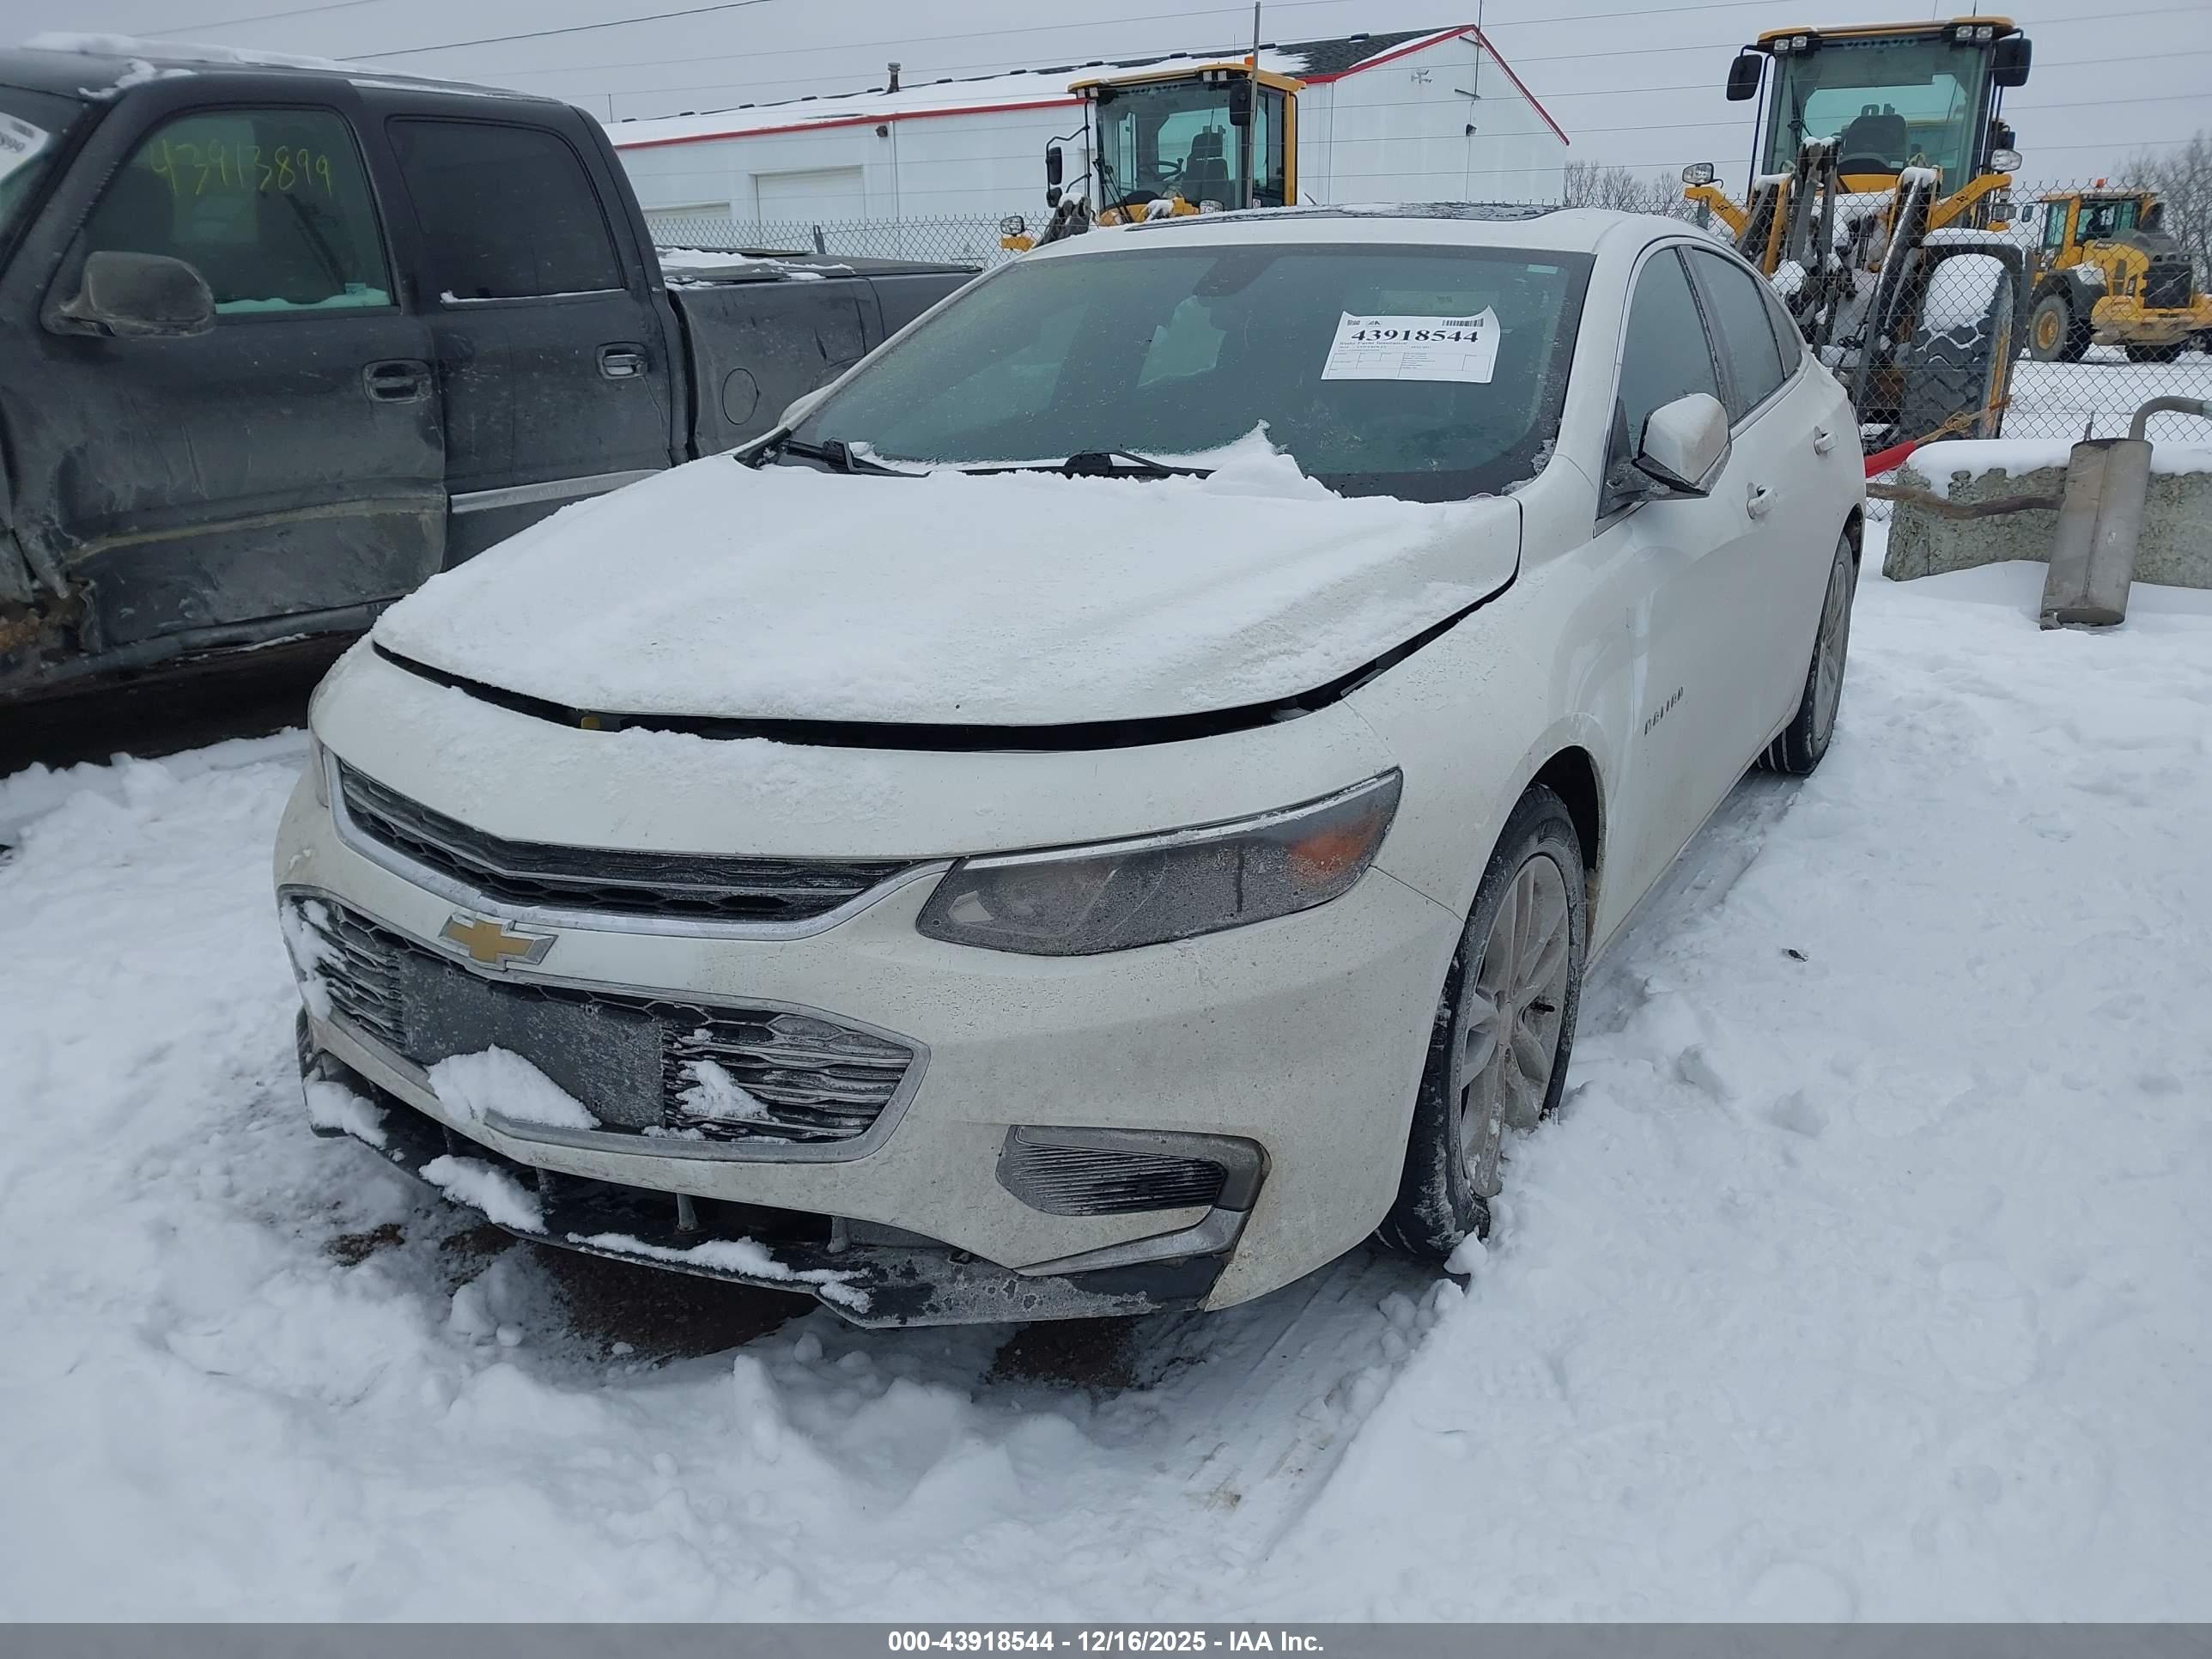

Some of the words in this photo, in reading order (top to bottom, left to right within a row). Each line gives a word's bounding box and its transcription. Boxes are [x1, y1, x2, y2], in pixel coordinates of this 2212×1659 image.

[1841, 37, 1918, 51] VOLVO
[149, 138, 332, 197] 43913899
[1351, 330, 1479, 343] 43918544
